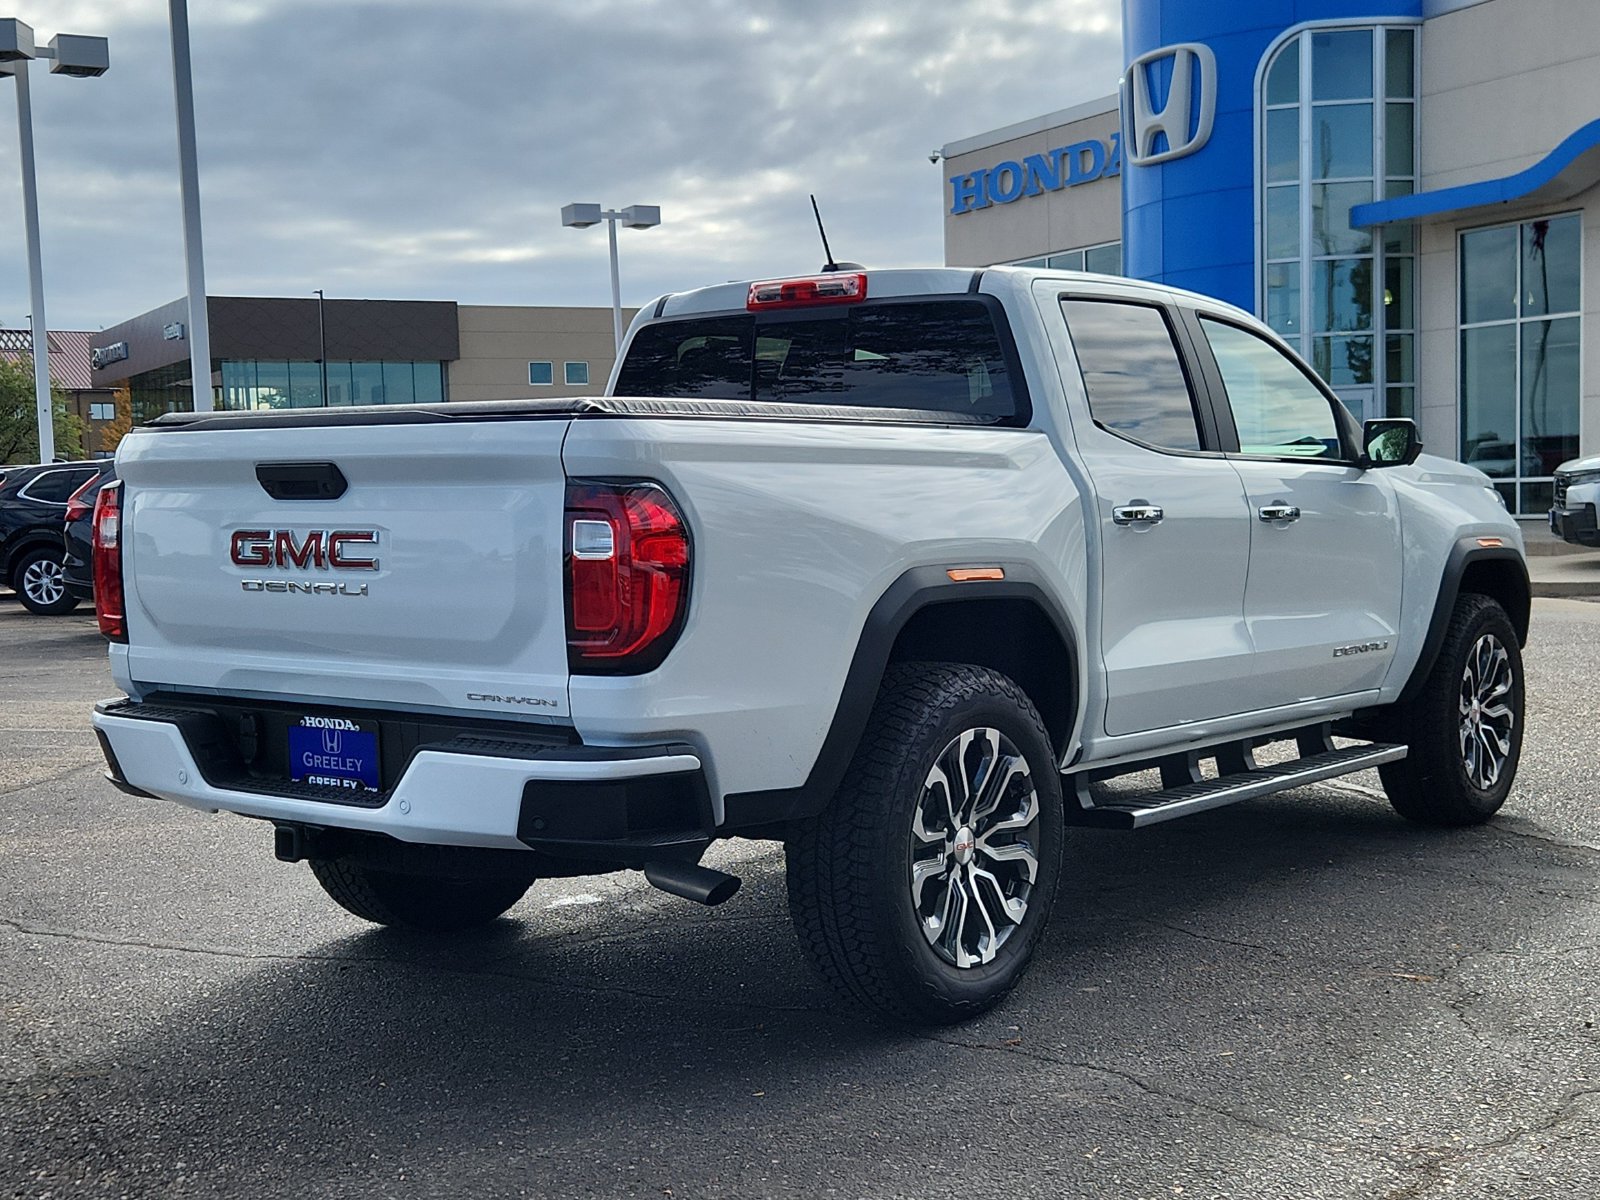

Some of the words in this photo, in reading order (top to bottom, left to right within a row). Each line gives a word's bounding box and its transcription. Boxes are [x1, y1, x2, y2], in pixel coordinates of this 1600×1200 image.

[230, 529, 379, 571] GMC
[241, 579, 368, 596] DENALI
[1332, 640, 1388, 657] DENALI
[467, 693, 557, 707] CANYON
[303, 716, 356, 731] HONDA
[303, 752, 363, 771] GREELEY
[308, 776, 358, 789] GREELEY
[956, 842, 974, 852] GMC
